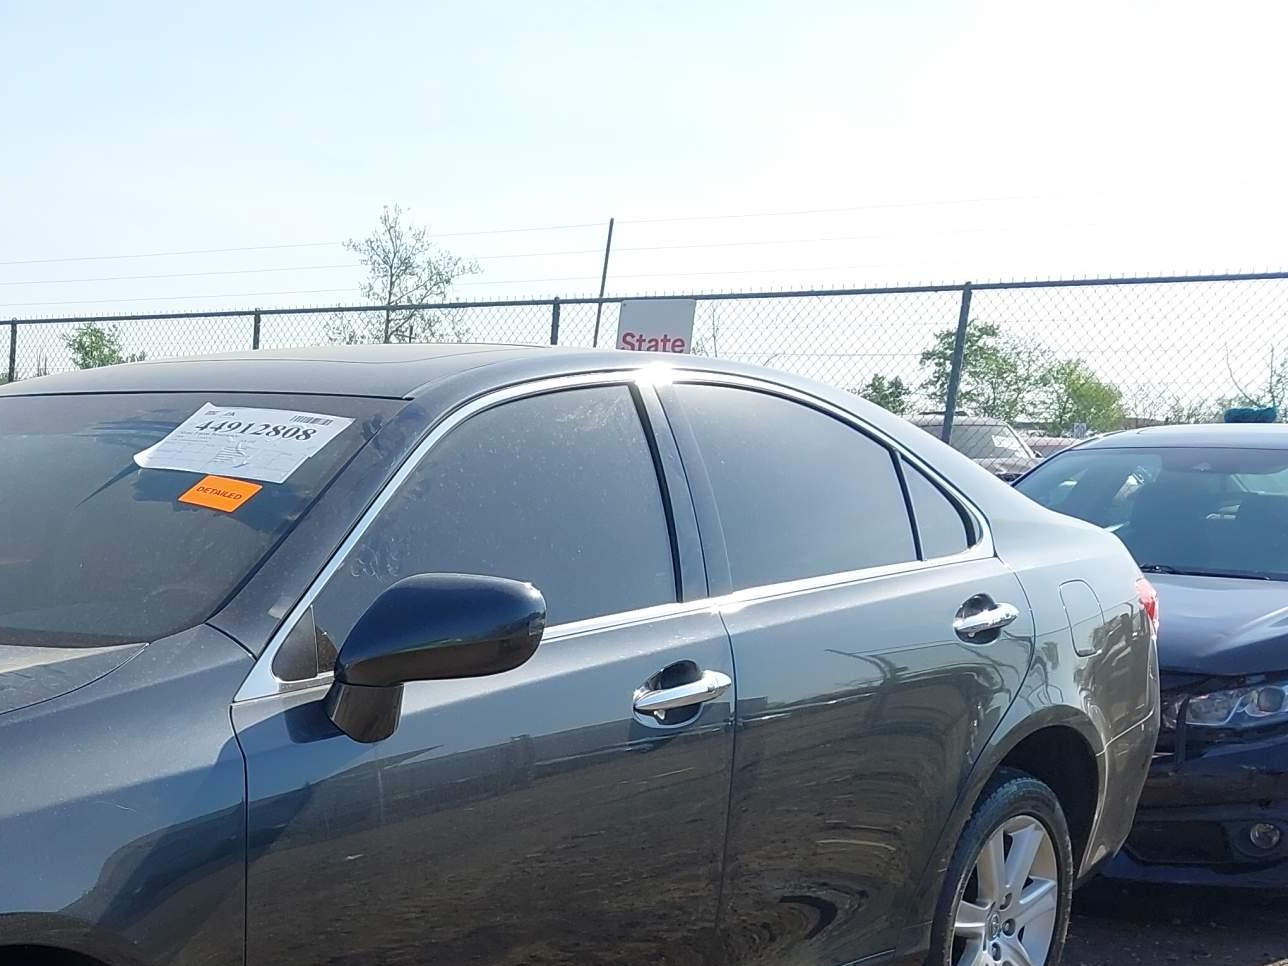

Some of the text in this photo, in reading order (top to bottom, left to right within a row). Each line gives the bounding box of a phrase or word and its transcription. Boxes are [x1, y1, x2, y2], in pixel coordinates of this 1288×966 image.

[622, 332, 685, 353] State
[196, 420, 317, 441] 44912808
[196, 485, 242, 501] DETAILED
